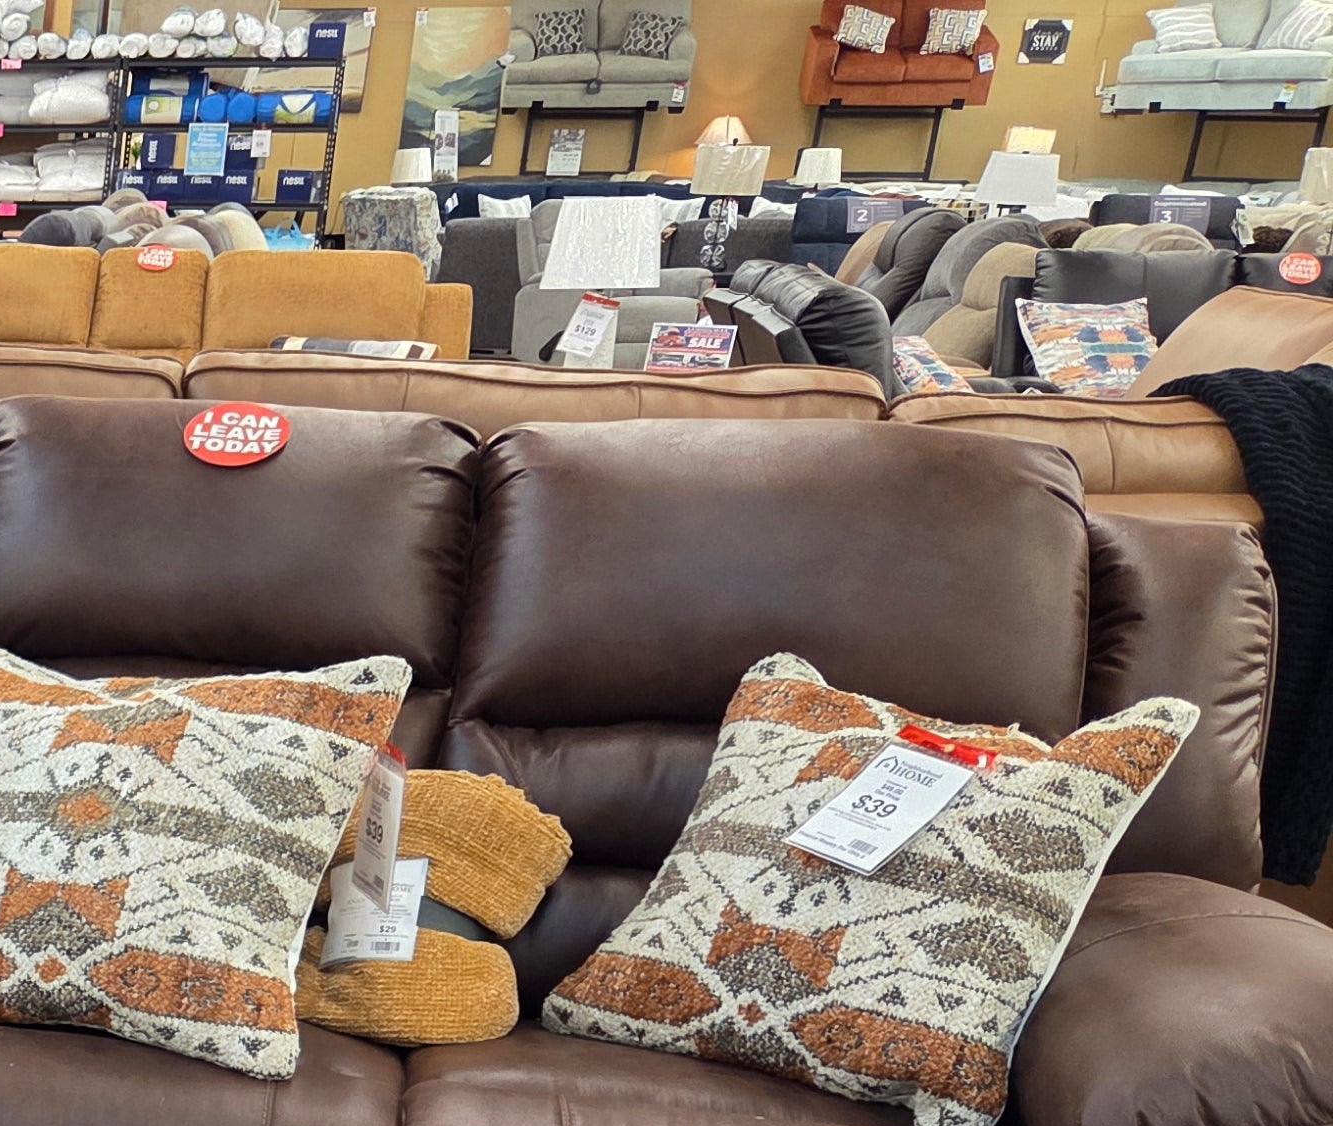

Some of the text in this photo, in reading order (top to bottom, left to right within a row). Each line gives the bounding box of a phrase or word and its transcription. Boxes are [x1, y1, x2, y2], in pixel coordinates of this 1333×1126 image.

[1033, 34, 1059, 47] STAY
[856, 209, 868, 222] 2
[1160, 210, 1172, 223] 3
[574, 324, 596, 336] $129
[687, 337, 723, 348] SALE
[203, 411, 280, 428] I CAN
[193, 423, 282, 441] LEAVE
[188, 436, 281, 454] TODAY
[893, 766, 937, 788] HOME
[852, 794, 897, 818] $39
[366, 817, 383, 844] $39
[379, 925, 396, 933] $29
